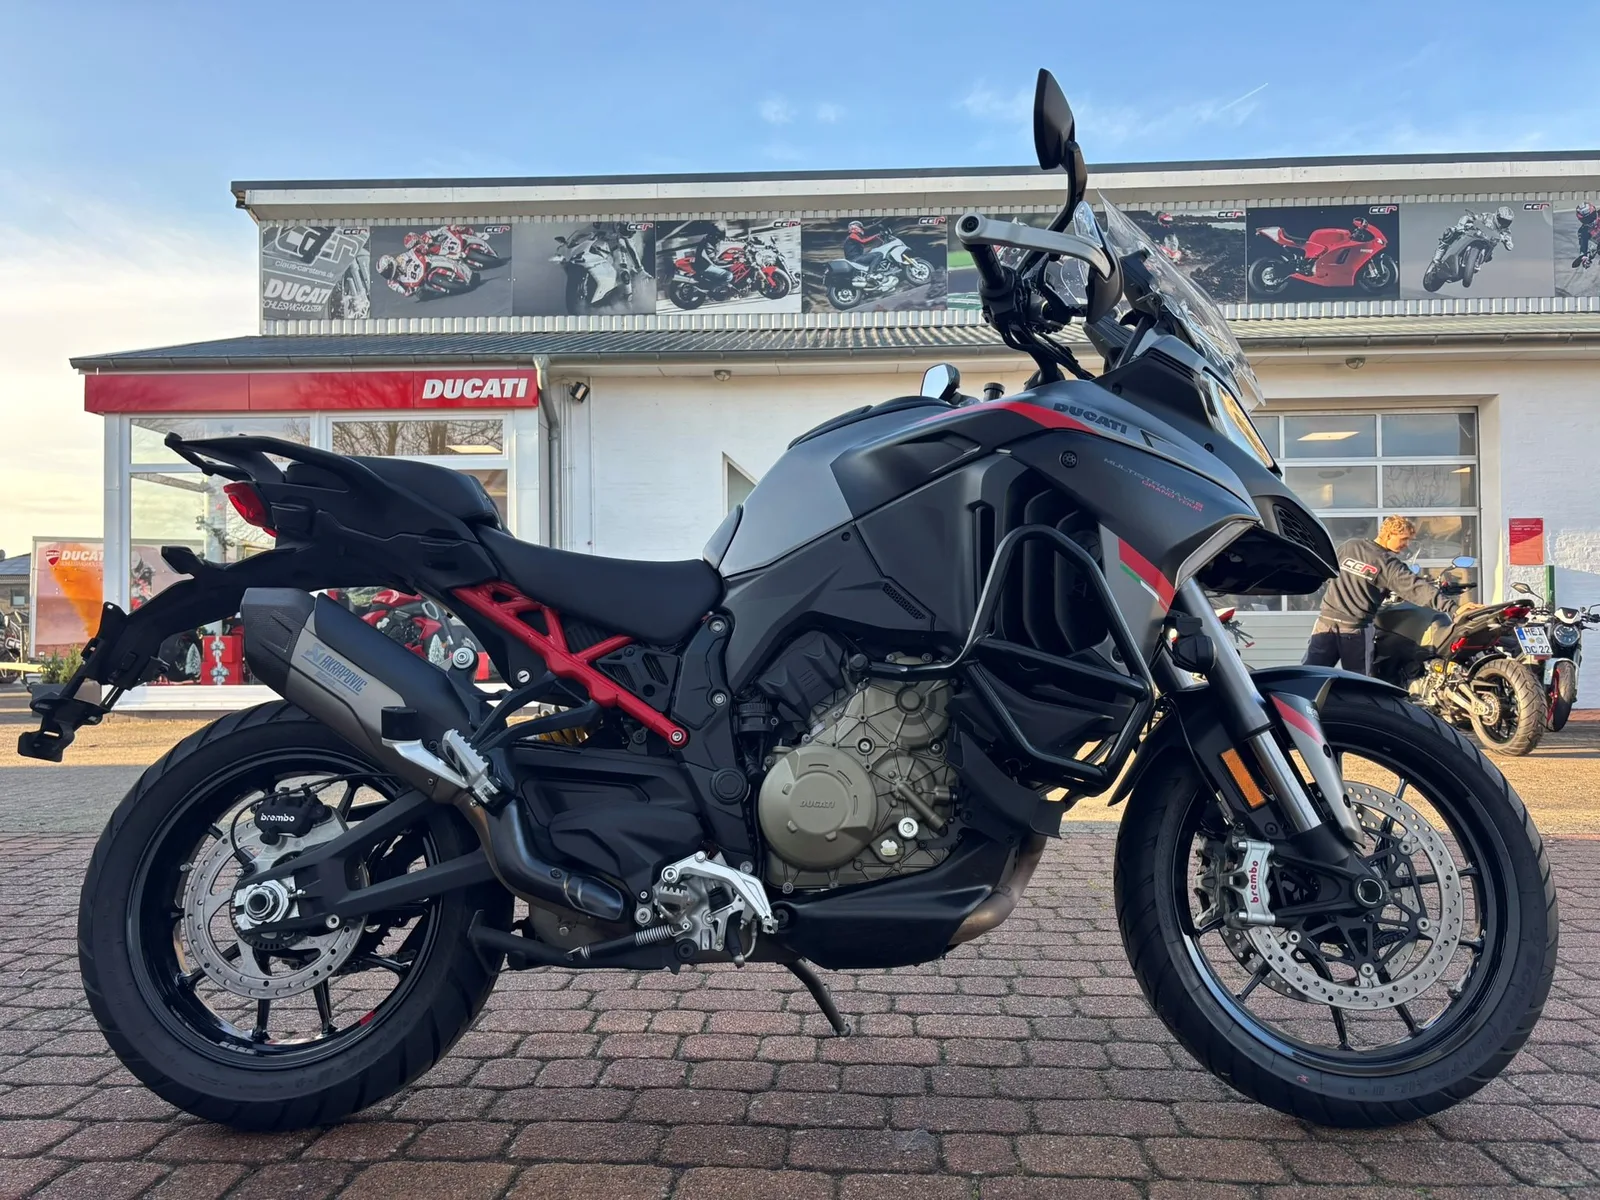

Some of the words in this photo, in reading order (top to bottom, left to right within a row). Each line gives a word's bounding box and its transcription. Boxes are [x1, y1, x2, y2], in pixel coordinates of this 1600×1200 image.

[264, 279, 332, 304] DUCATI
[422, 378, 528, 399] DUCATI
[1053, 403, 1128, 435] DUCATI
[1538, 646, 1551, 654] 22
[799, 800, 836, 809] DUCATI
[260, 813, 295, 822] brembo
[1249, 860, 1259, 904] brembo
